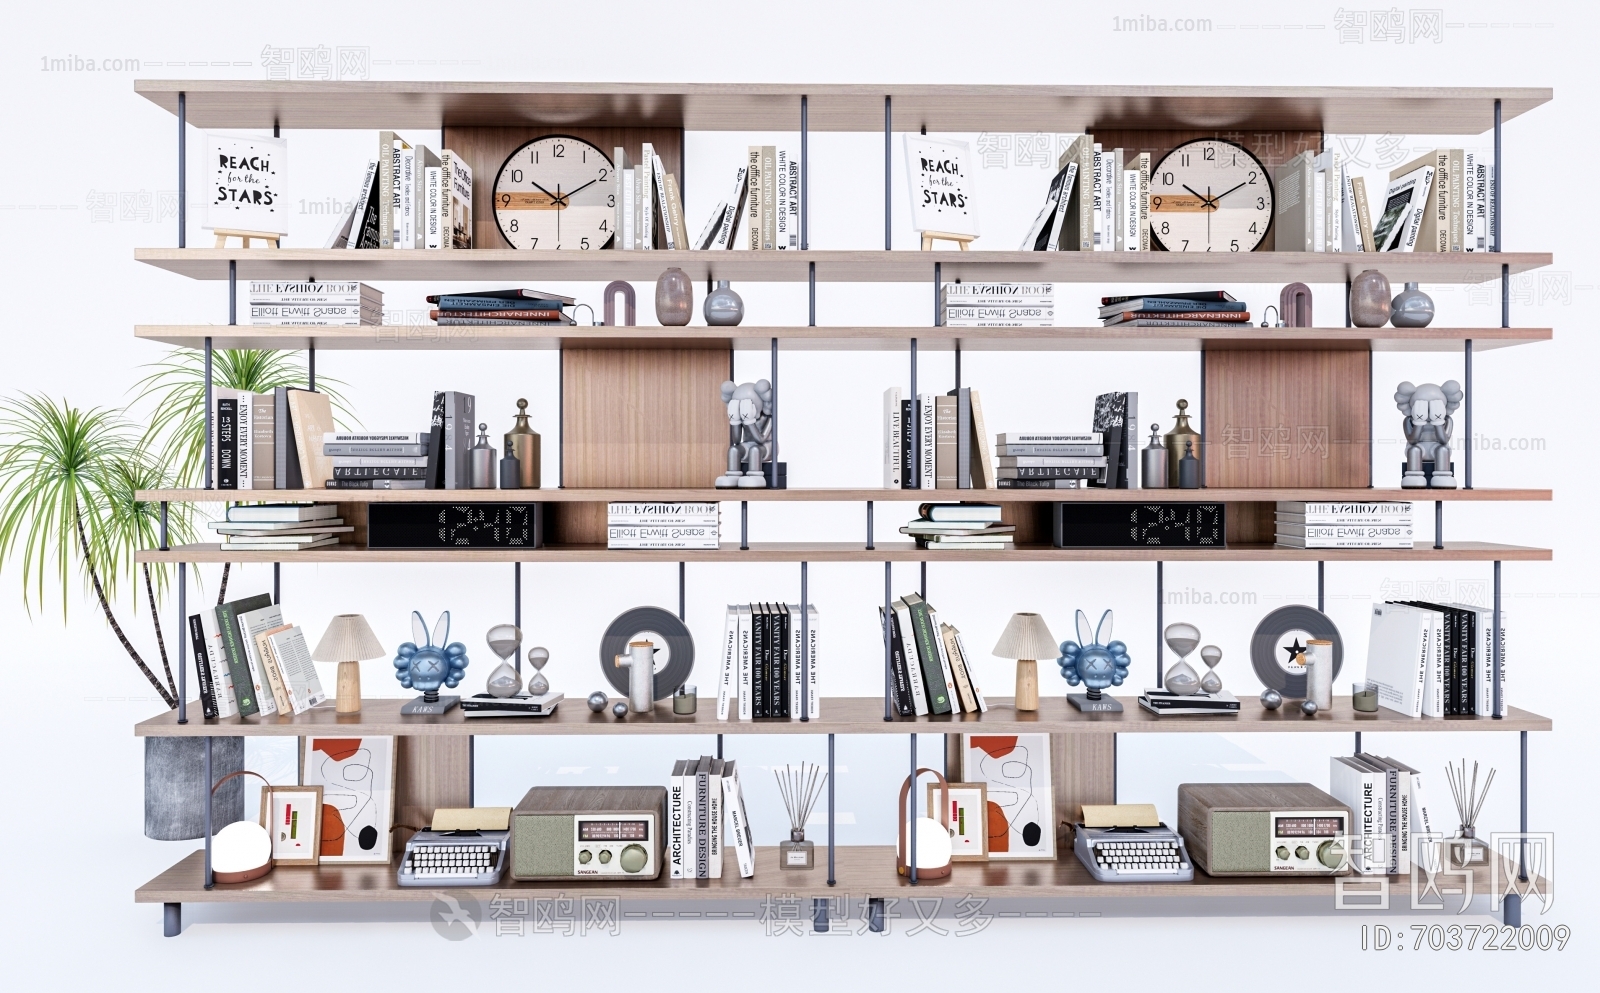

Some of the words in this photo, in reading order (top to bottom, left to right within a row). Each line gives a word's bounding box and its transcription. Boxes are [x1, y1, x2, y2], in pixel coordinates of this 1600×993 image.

[553, 144, 565, 158] 12
[1204, 148, 1215, 160] 12
[220, 154, 269, 172] REACH
[920, 158, 958, 175] REACH
[1182, 154, 1190, 167] 11
[1438, 154, 1448, 166] the
[511, 170, 522, 182] 10
[598, 168, 608, 182] 2
[789, 161, 798, 200] ABSTRACT
[929, 174, 940, 186] for
[1162, 172, 1174, 186] 10
[1248, 172, 1257, 184] 2
[1476, 164, 1485, 202] ABSTRACT
[218, 186, 272, 206] STARS
[502, 194, 511, 208] 9
[607, 194, 615, 208] 3
[750, 188, 760, 218] furniture
[924, 189, 965, 208] STARS
[1153, 196, 1162, 210] 9
[1256, 197, 1265, 210] 3
[789, 201, 798, 216] ART
[1356, 182, 1364, 204] Frank
[1360, 206, 1370, 229] Gehry
[1438, 190, 1448, 220] furniture
[1476, 204, 1485, 218] ART
[510, 219, 518, 232] 8
[1412, 208, 1424, 226] Digital
[599, 220, 608, 232] 4
[1161, 222, 1170, 234] 8
[1248, 222, 1258, 234] 4
[531, 238, 538, 250] 7
[580, 238, 590, 250] 5
[1406, 225, 1420, 247] painting
[1182, 240, 1190, 252] 7
[1230, 240, 1240, 252] 5
[239, 404, 248, 426] ENJOY
[924, 405, 932, 426] ENJOY
[222, 424, 231, 442] STEPS
[239, 426, 248, 448] EVERY
[924, 426, 932, 448] EVERY
[222, 449, 231, 470] DOWN
[239, 448, 248, 478] MOMENT
[924, 448, 932, 478] MOMENT
[1130, 506, 1218, 544] 12:40
[698, 774, 706, 836] FURNITURE
[672, 786, 681, 866] ARCHITECTURE
[732, 810, 740, 828] MARCEL
[1364, 782, 1372, 861] ARCHITECTURE
[698, 838, 706, 878] DESIGN
